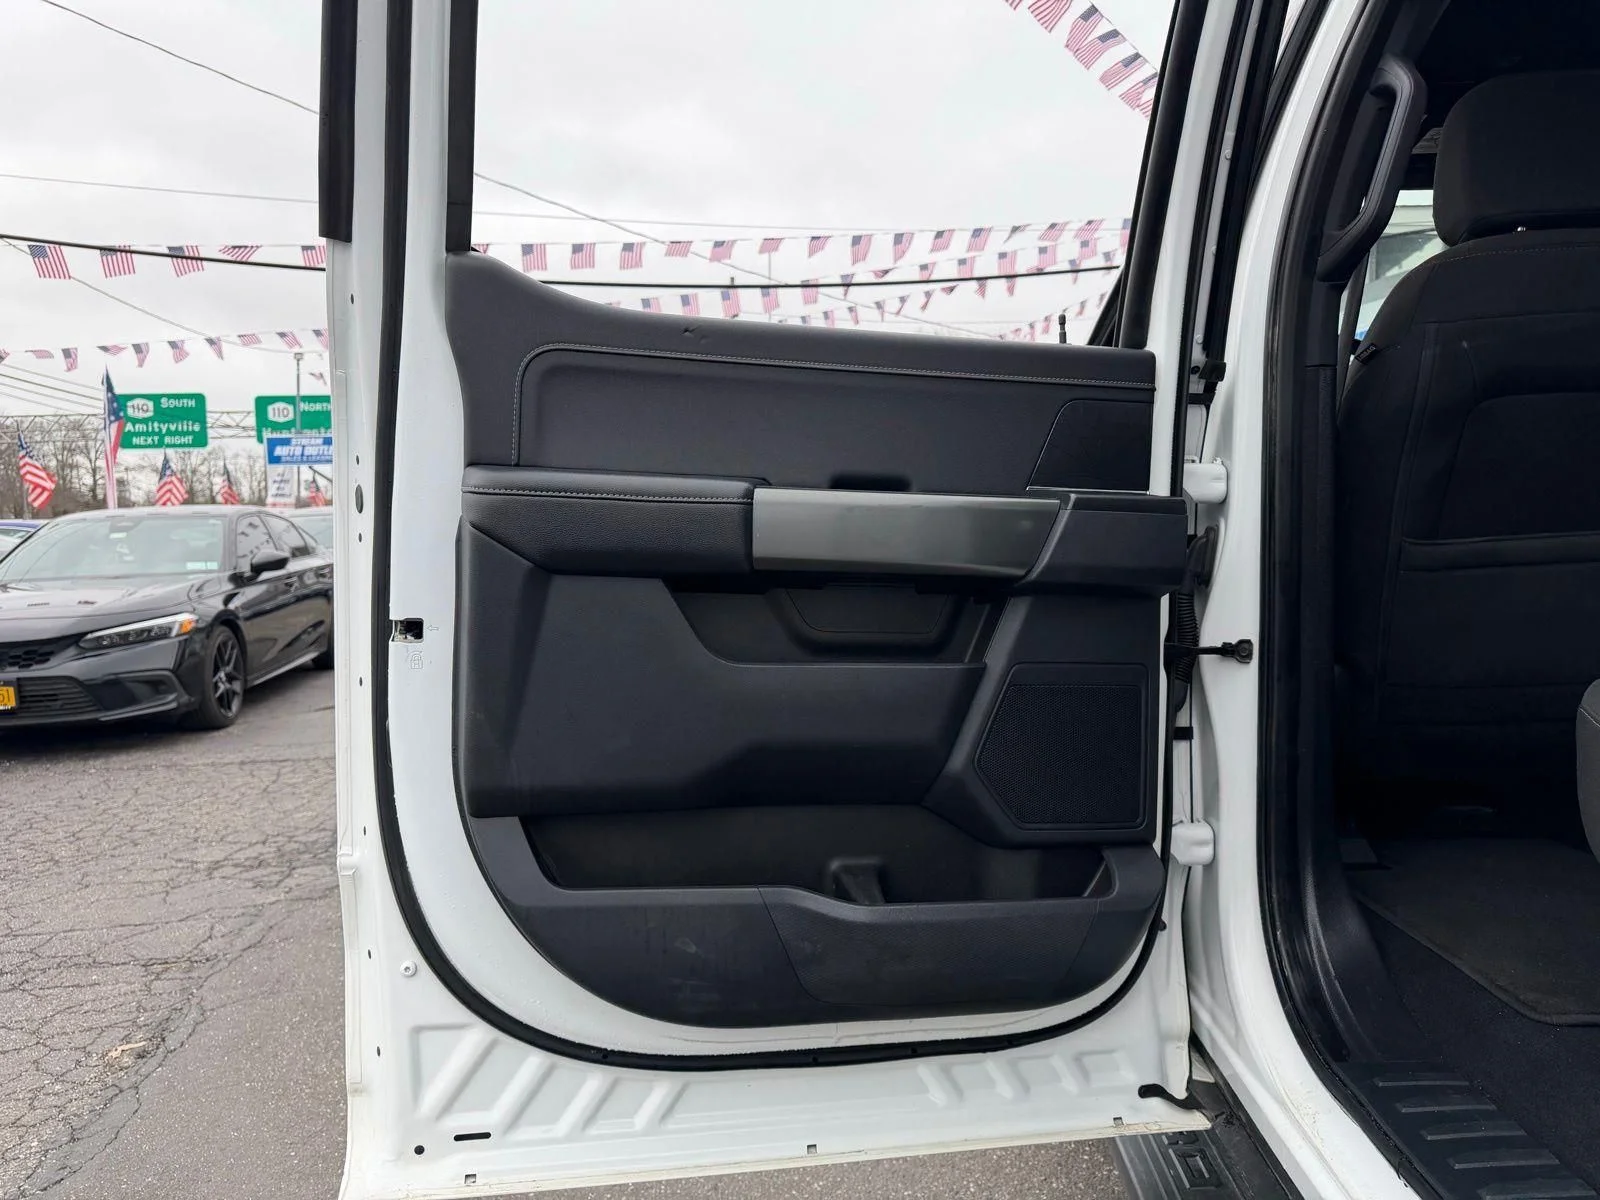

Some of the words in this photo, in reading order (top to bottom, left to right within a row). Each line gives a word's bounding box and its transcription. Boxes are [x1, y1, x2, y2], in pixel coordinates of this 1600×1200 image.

[160, 397, 196, 408] SOUTH
[131, 403, 150, 414] 110
[272, 407, 290, 418] 110
[124, 421, 201, 434] Amityville
[132, 435, 160, 446] NEXT
[164, 435, 194, 445] RIGHT
[273, 445, 304, 456] AUTO
